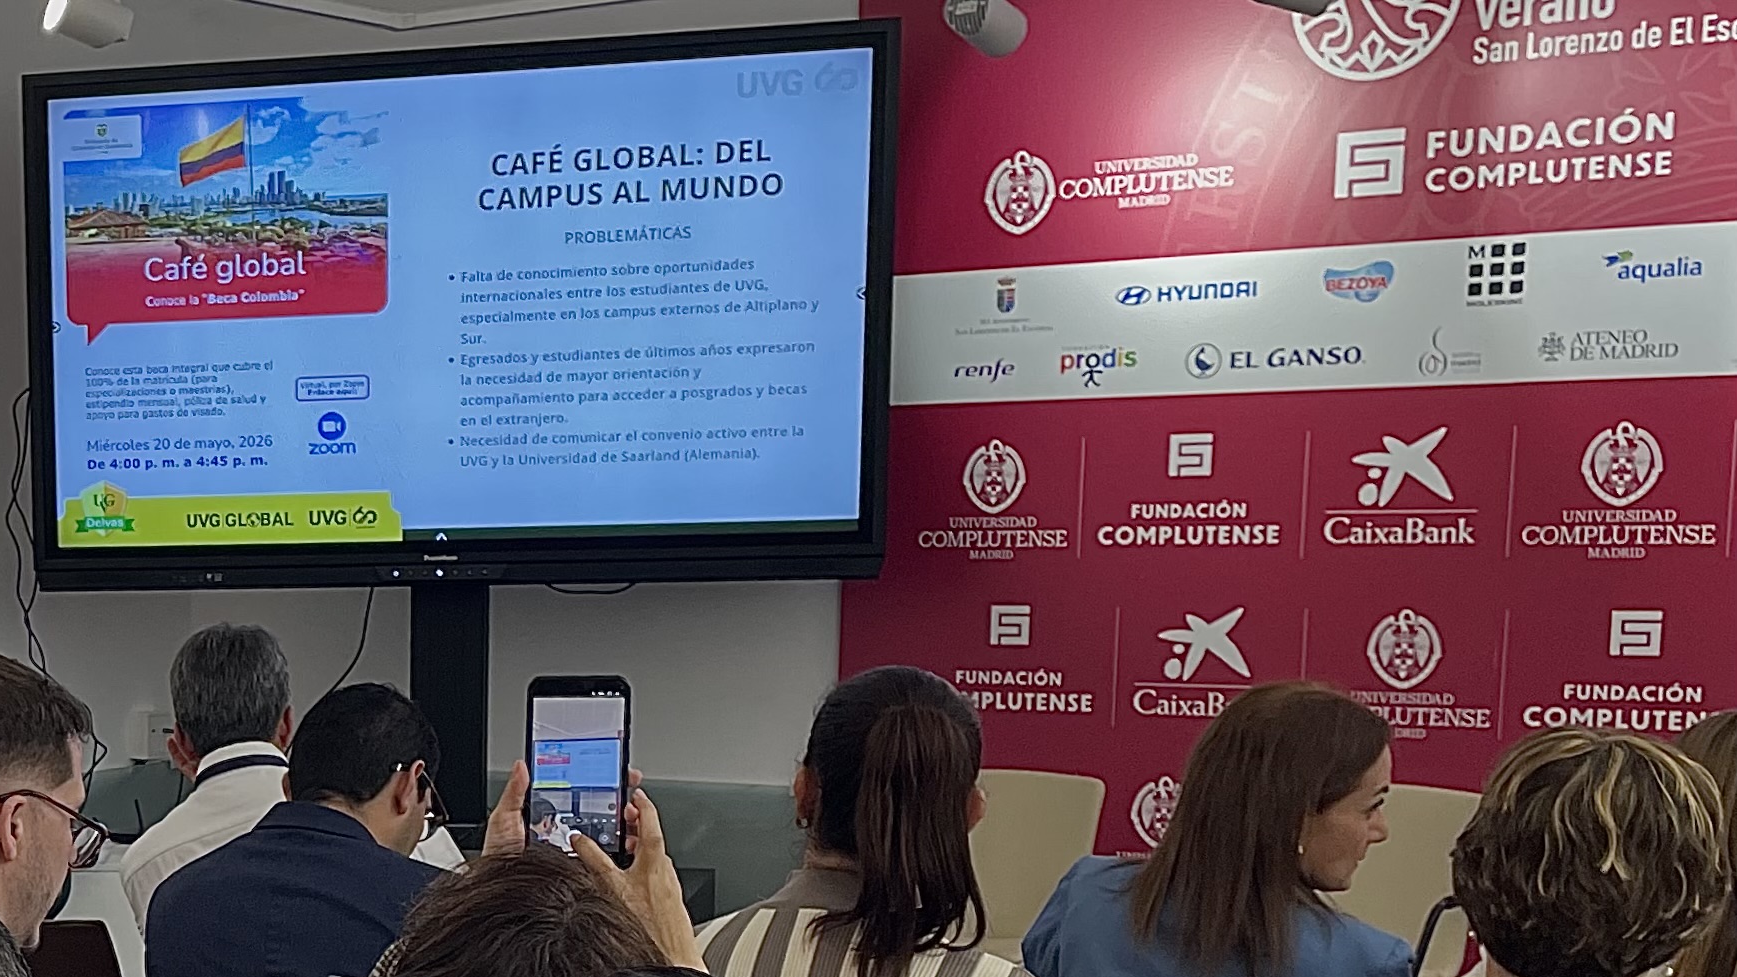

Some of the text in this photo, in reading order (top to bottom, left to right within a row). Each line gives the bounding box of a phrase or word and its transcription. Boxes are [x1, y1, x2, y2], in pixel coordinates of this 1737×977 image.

[1476, 0, 1616, 31] Verano
[1472, 36, 1519, 65] San
[1526, 29, 1623, 60] Lorenzo
[1631, 20, 1662, 49] de
[1669, 16, 1694, 46] El
[737, 69, 803, 98] UVG
[1426, 107, 1676, 159] FUNDACIÓN
[492, 139, 771, 176] CAFÉ GLOBAL: DEL
[1094, 153, 1199, 175] UNIVERSIDAD
[1059, 166, 1235, 200] COMPLUTENSE
[1425, 151, 1673, 193] COMPLUTENSE
[478, 173, 784, 210] CAMPUS AL MUNDO
[1118, 194, 1171, 209] MADRID
[565, 224, 692, 244] PROBLEMÁTICAS
[144, 250, 306, 284] Café global
[460, 259, 755, 283] Falta de conocimiento sobre oportunidades
[1616, 256, 1703, 284] aqualia
[460, 288, 563, 303] internacionales
[567, 286, 602, 299] entre
[606, 285, 625, 297] los
[630, 282, 709, 296] estudiantes
[713, 280, 731, 292] de
[1157, 281, 1258, 303] HYUNDAI
[1325, 276, 1388, 293] BEZOYA
[460, 299, 819, 325] especialmente en los campus externos de Altiplano y
[460, 334, 487, 345] Sur.
[1570, 329, 1648, 346] ATENEO
[460, 342, 815, 368] Egresados y estudiantes de últimos años expresaron
[1060, 347, 1138, 375] prodis
[1230, 346, 1362, 369] EL GANSO
[1570, 342, 1679, 361] DE MADRID
[461, 367, 702, 386] la necesidad de mayor orientación y
[954, 357, 1015, 384] renfe
[460, 383, 808, 408] acompañamiento para acceder a posgrados y becas
[460, 413, 569, 427] en el extranjero.
[87, 435, 273, 452] Miércoles 20 de mayo, 2026
[460, 425, 804, 447] Necesidad de comunicar el convenio activo entre la
[308, 442, 356, 455] zoom
[460, 455, 488, 467] UVG
[491, 456, 499, 469] y
[503, 454, 514, 466] la
[519, 451, 597, 466] Universidad
[601, 451, 617, 463] de
[621, 449, 680, 463] Saarland
[87, 459, 105, 469] De
[109, 458, 140, 469] 4:00
[183, 458, 192, 467] a
[196, 455, 228, 467] 4:45
[187, 512, 293, 528] UVG GLOBAL
[309, 509, 347, 526] UVG
[1130, 499, 1247, 520] FUNDACIÓN
[1563, 509, 1677, 523] UNIVERSIDAD
[949, 517, 1037, 529] UNIVERSIDAD
[1323, 517, 1475, 545] CaixaBank
[918, 530, 1068, 549] COMPLUTENSE
[1097, 524, 1280, 546] COMPLUTENSE
[1521, 524, 1717, 546] COMPLUTENSE
[969, 550, 1014, 560] MADRID
[1587, 547, 1646, 560] MADRID
[955, 668, 1062, 687] FUNDACIÓN
[961, 690, 1093, 713] MPLUTENSE
[1133, 689, 1230, 717] CaixaB
[1563, 682, 1703, 703] FUNDACIÓN
[1369, 706, 1492, 729] LUTENSE
[1522, 705, 1720, 731] COMPLUTEN
